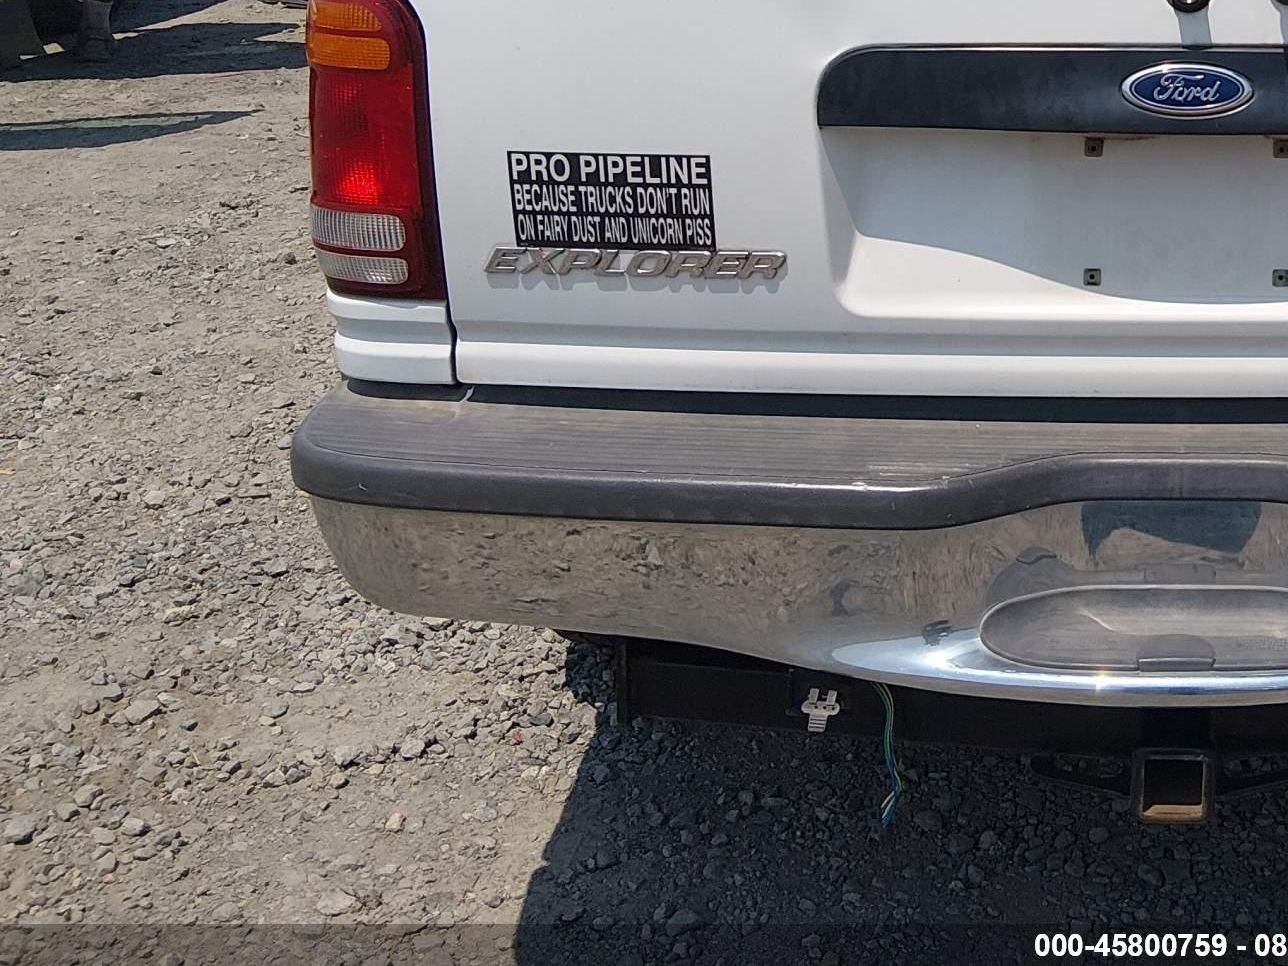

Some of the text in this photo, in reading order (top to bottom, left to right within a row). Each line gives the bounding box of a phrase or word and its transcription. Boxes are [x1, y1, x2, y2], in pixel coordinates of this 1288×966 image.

[1153, 73, 1221, 102] Ford
[510, 153, 708, 184] PRO PIPELINE
[514, 184, 710, 215] BECAUSE TRUCKS DON'T RUN
[517, 215, 712, 246] ON FAIRY DUST AND UNICORN PISS
[484, 246, 788, 280] EXPLORER
